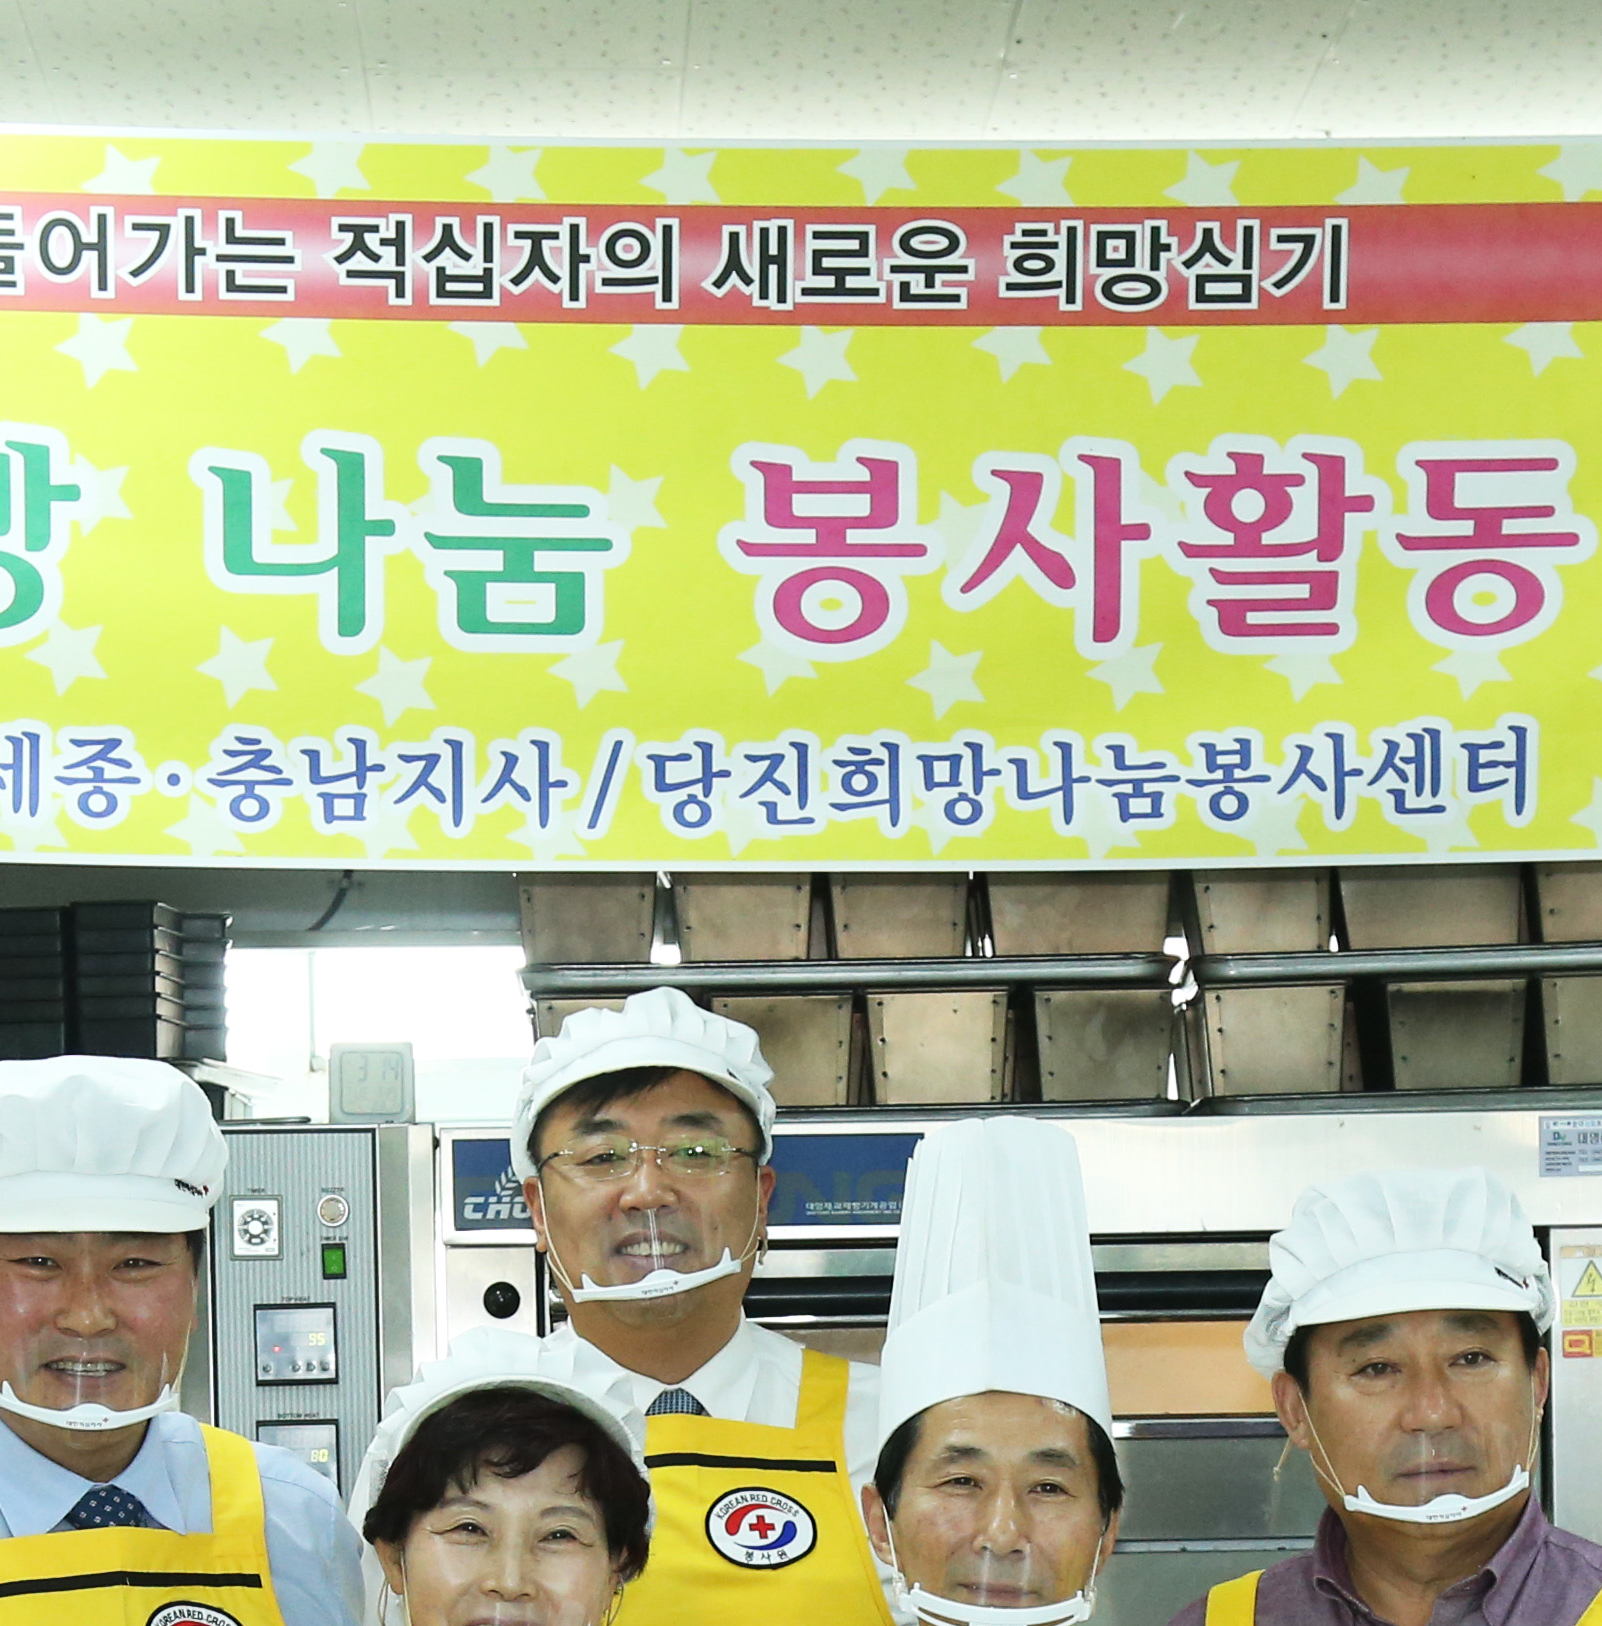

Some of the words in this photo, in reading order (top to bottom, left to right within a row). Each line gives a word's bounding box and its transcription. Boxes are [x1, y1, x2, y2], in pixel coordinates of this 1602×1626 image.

[333, 217, 674, 305] 적십자의
[711, 222, 970, 306] 새로운
[1004, 222, 1343, 307] 희망심기
[207, 447, 614, 639] 나눔
[736, 452, 1581, 645] 봉사활동
[714, 1494, 749, 1520] KOREAN
[750, 1493, 768, 1503] RED
[771, 1496, 800, 1518] CROSS
[186, 1609, 203, 1621] RED
